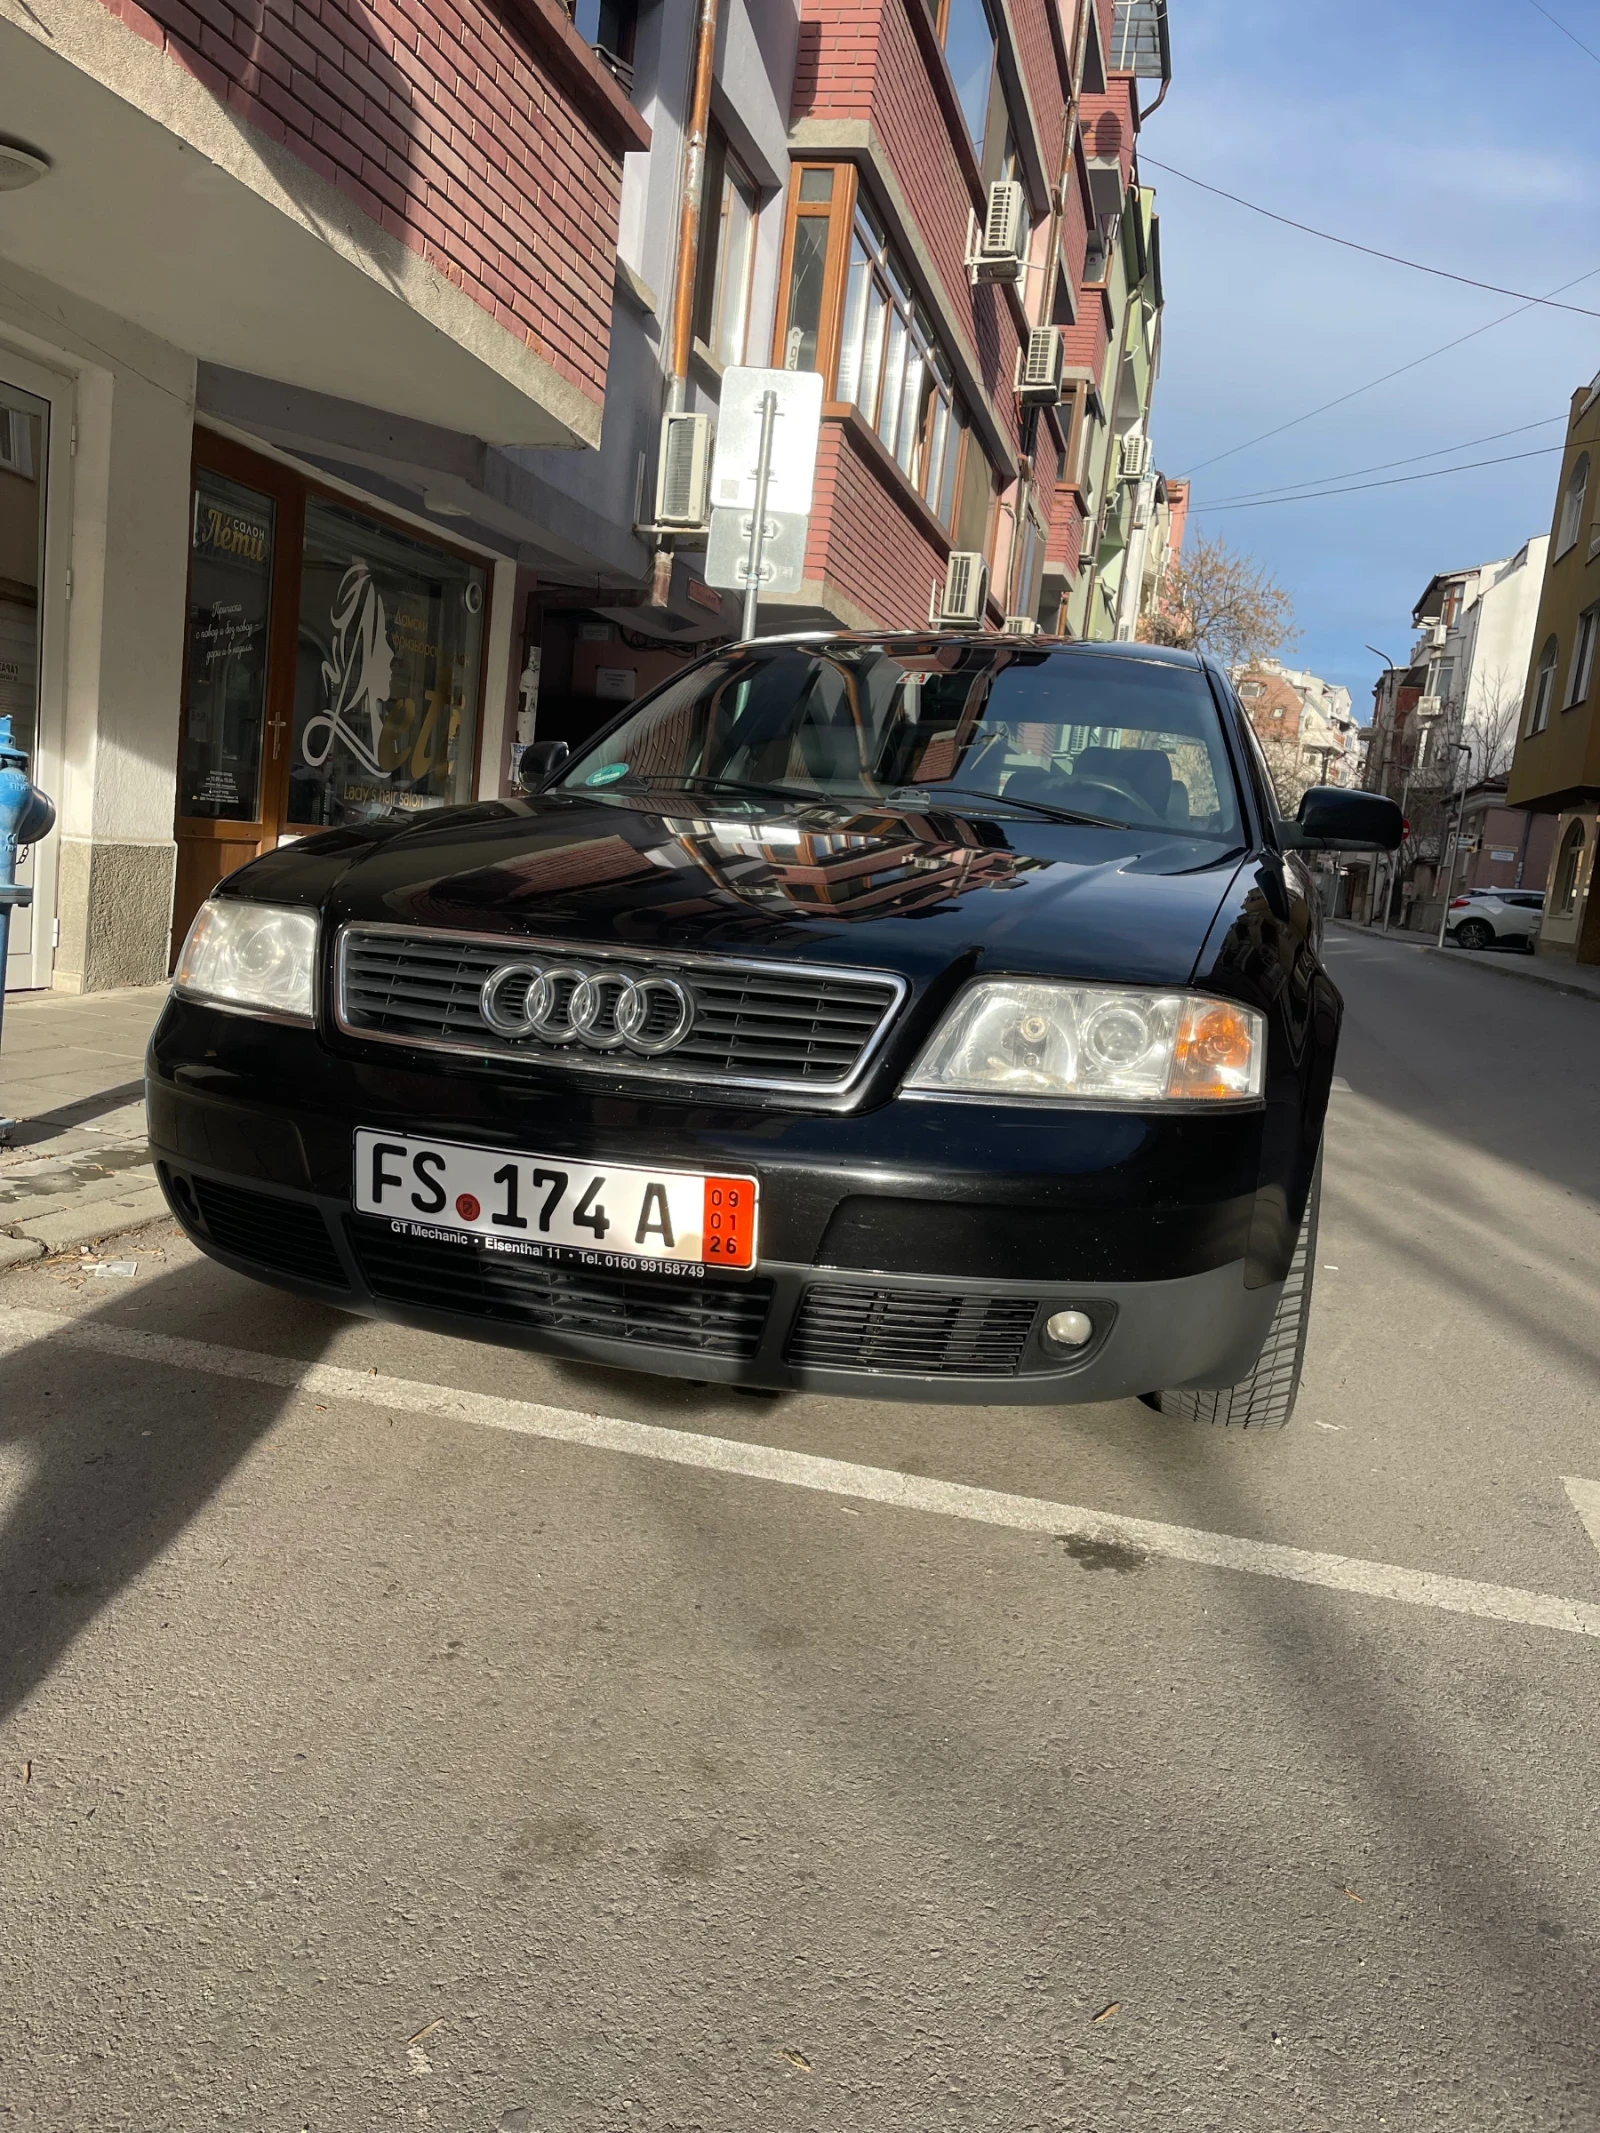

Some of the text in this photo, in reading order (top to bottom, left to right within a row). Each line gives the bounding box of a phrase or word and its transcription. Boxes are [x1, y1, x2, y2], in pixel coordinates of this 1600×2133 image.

[233, 519, 265, 541] салон
[393, 606, 428, 634] Дамски
[343, 781, 424, 808] Lady's hair salon
[372, 1142, 675, 1248] FS 174 A
[710, 1188, 739, 1208] 09
[710, 1212, 737, 1231] 01
[391, 1220, 705, 1278] GT Mechanic Eisenthal 11 Tel. 0160 99158749
[710, 1236, 738, 1255] 26
